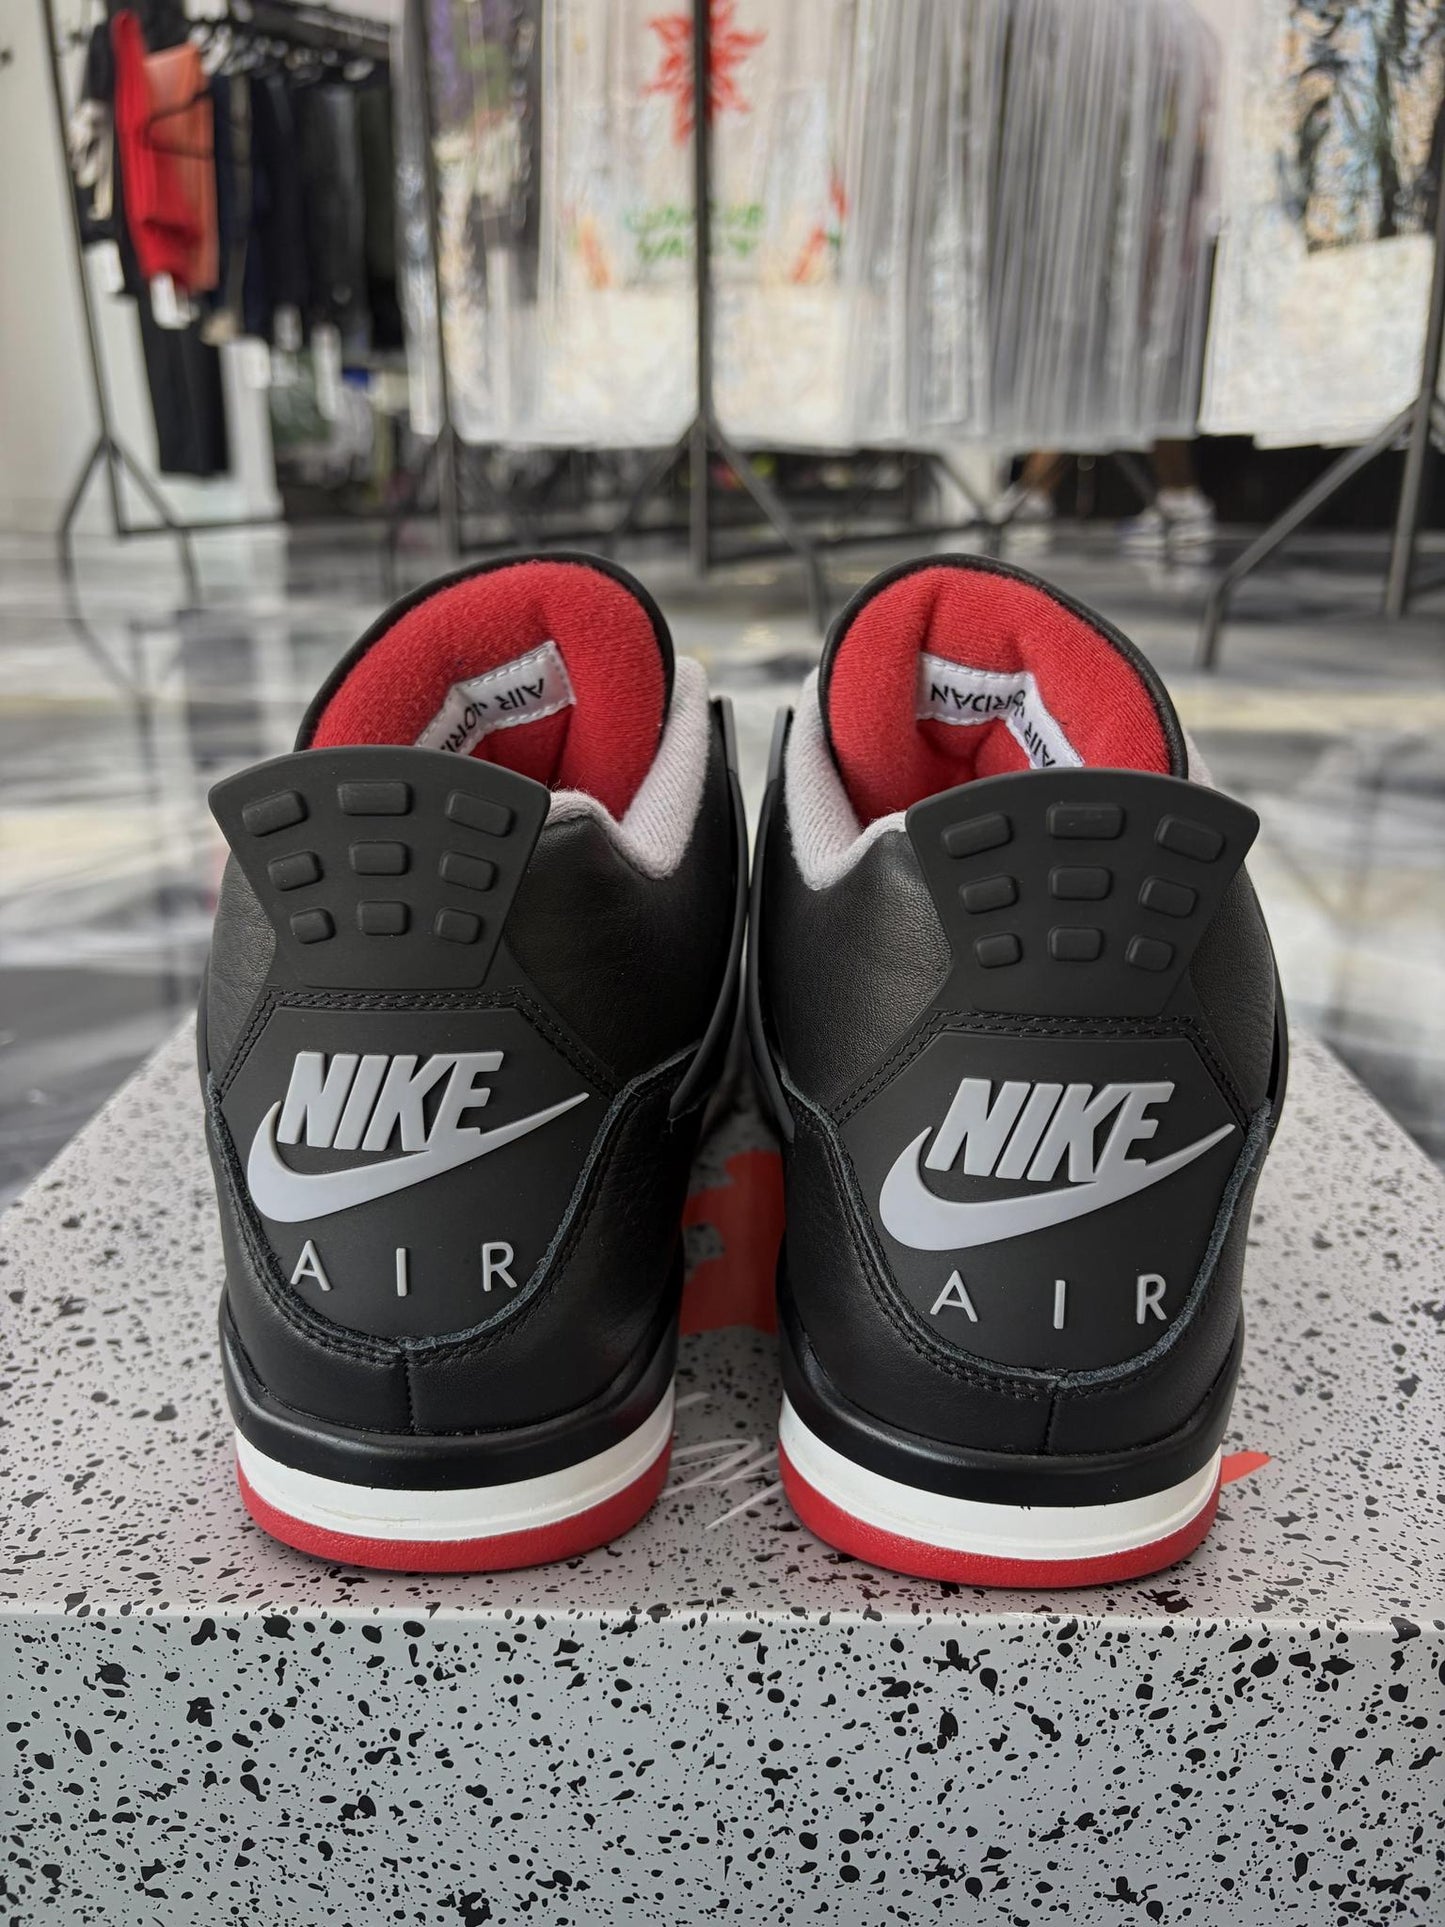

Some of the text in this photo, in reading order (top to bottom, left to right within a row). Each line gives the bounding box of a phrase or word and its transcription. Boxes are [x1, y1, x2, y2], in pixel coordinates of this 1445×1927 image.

[494, 678, 544, 711] AIR
[1024, 721, 1056, 768] AIR
[277, 1050, 504, 1152] NIKE
[925, 1077, 1175, 1183] NIKE
[290, 1240, 518, 1297] AIR
[929, 1269, 1168, 1330] AIR
